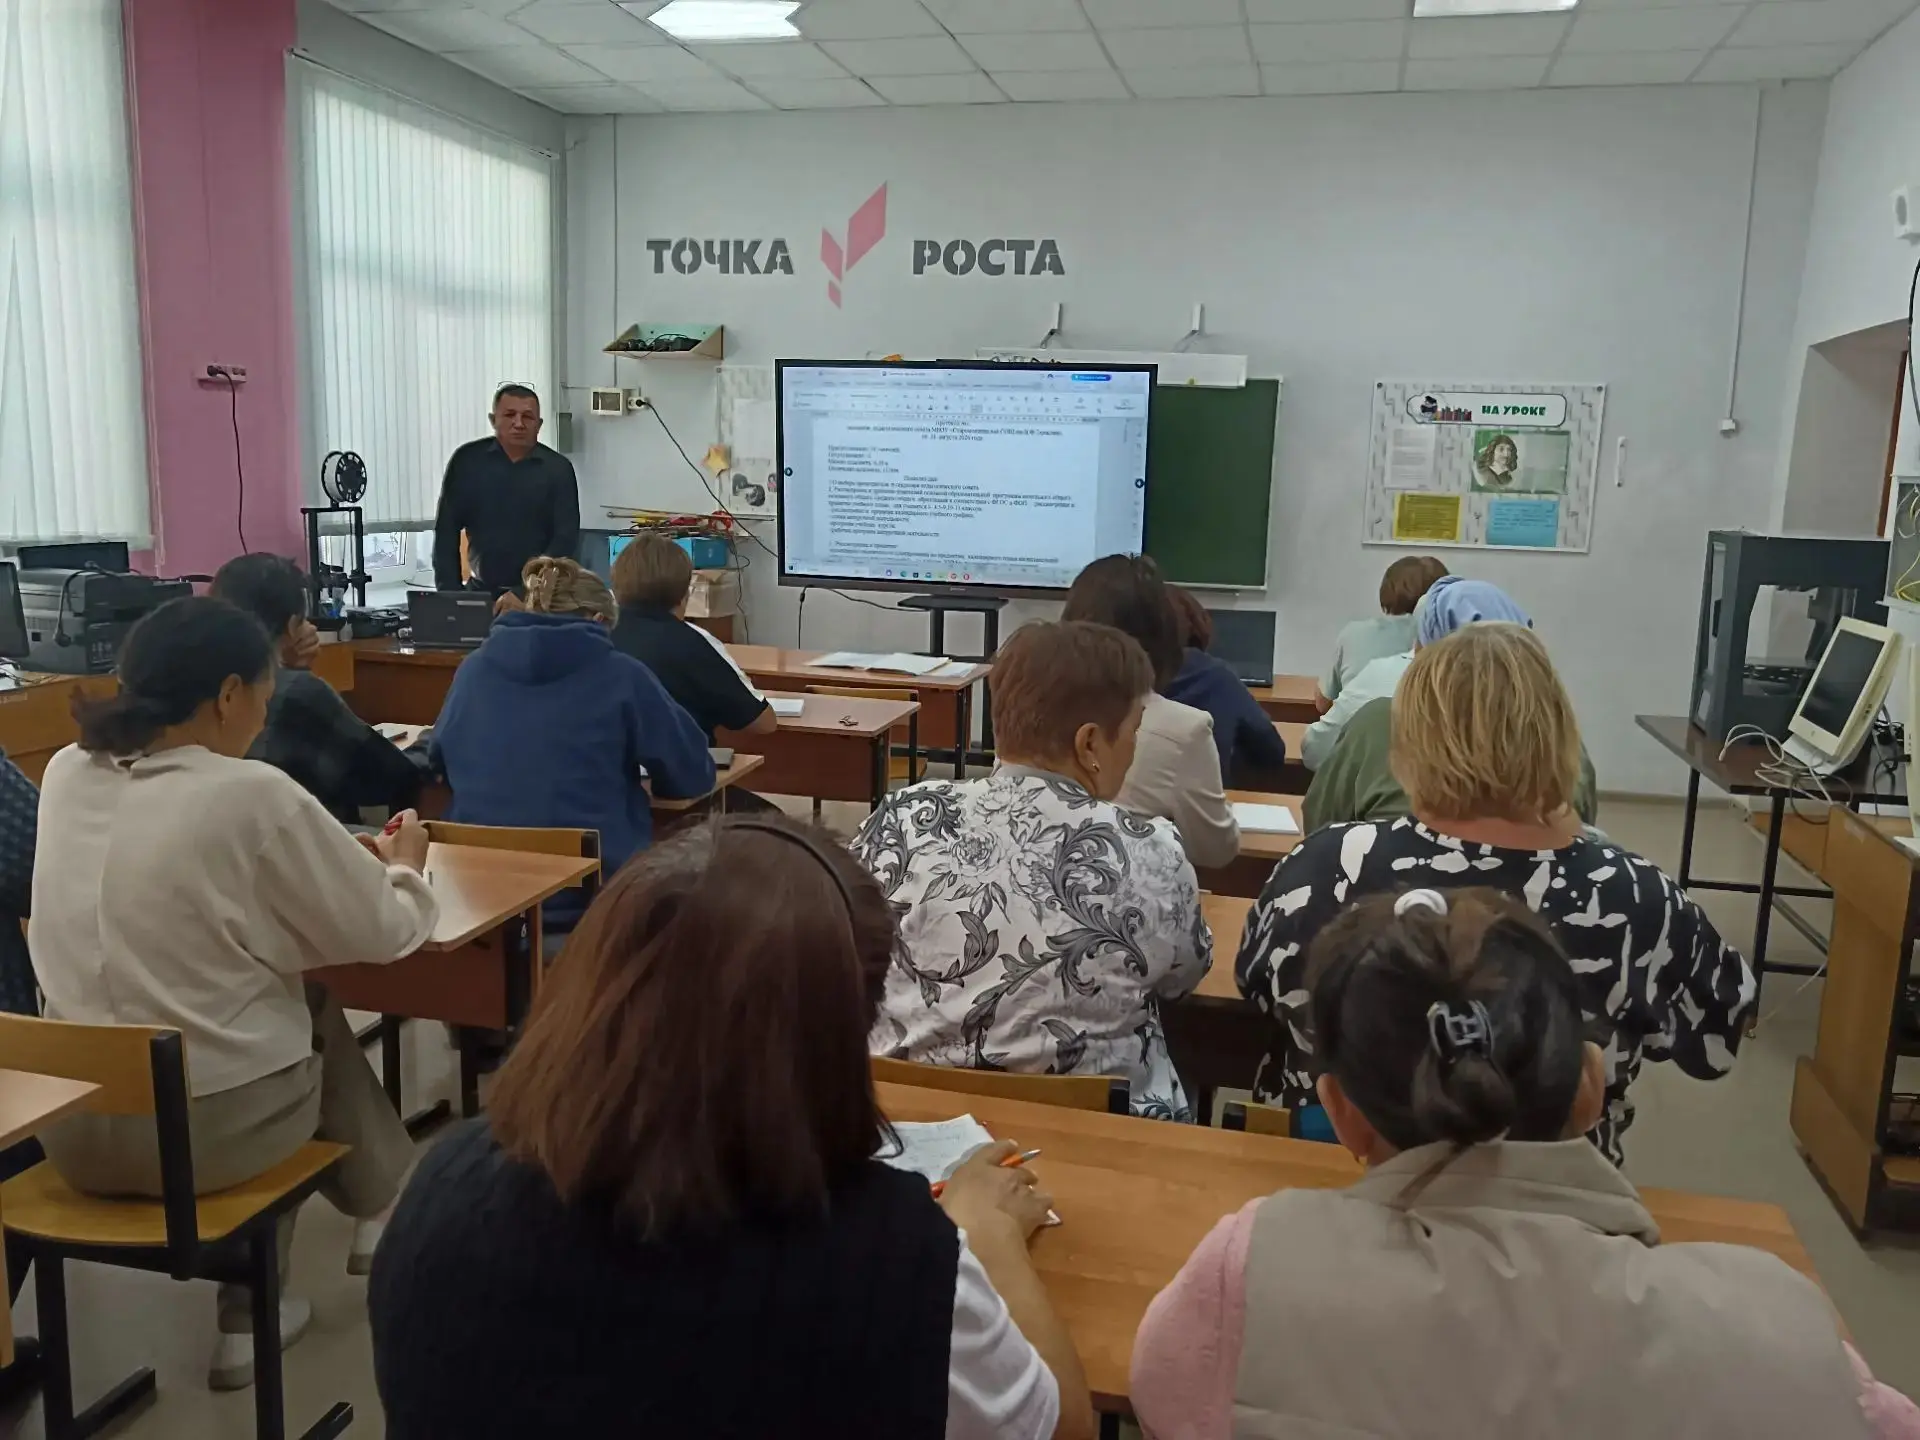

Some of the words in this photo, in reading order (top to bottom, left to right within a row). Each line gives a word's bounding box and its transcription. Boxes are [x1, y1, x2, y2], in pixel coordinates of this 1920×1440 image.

[646, 237, 795, 276] ТОЧКА
[913, 238, 1066, 276] РОСТА
[1482, 405, 1499, 415] НА
[1503, 405, 1546, 416] УРОКЕ
